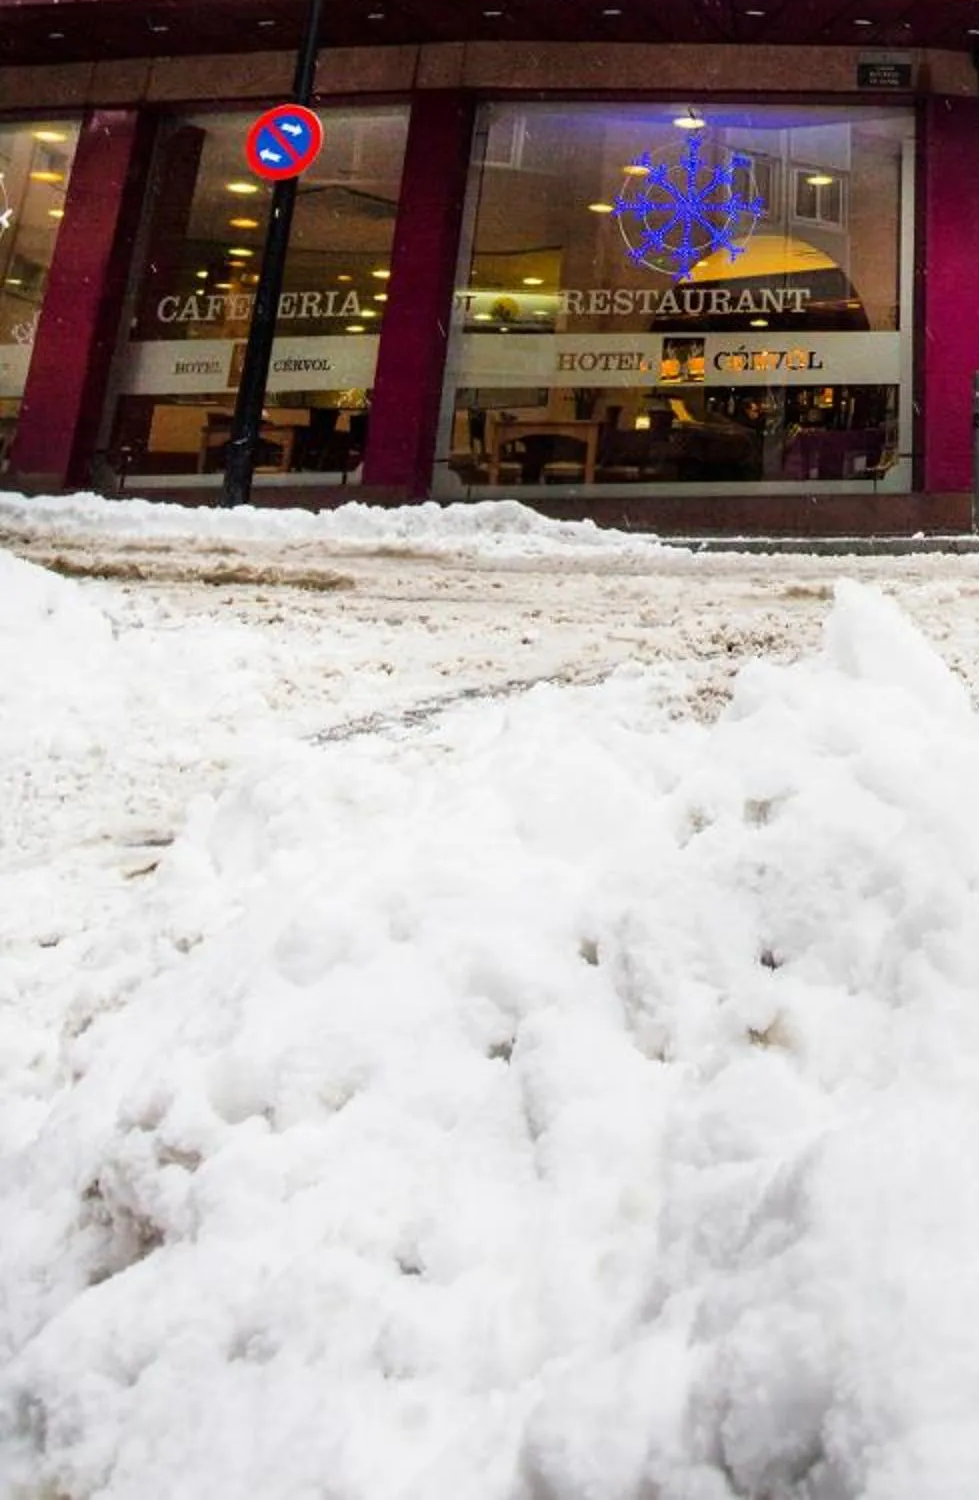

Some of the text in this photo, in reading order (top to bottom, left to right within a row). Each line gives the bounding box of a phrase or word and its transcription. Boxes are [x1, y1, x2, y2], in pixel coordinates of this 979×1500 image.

[157, 290, 362, 322] CAFEERIA
[560, 289, 811, 315] RESTAURANT
[173, 360, 223, 375] HOTEL
[557, 352, 652, 371] HOTEL
